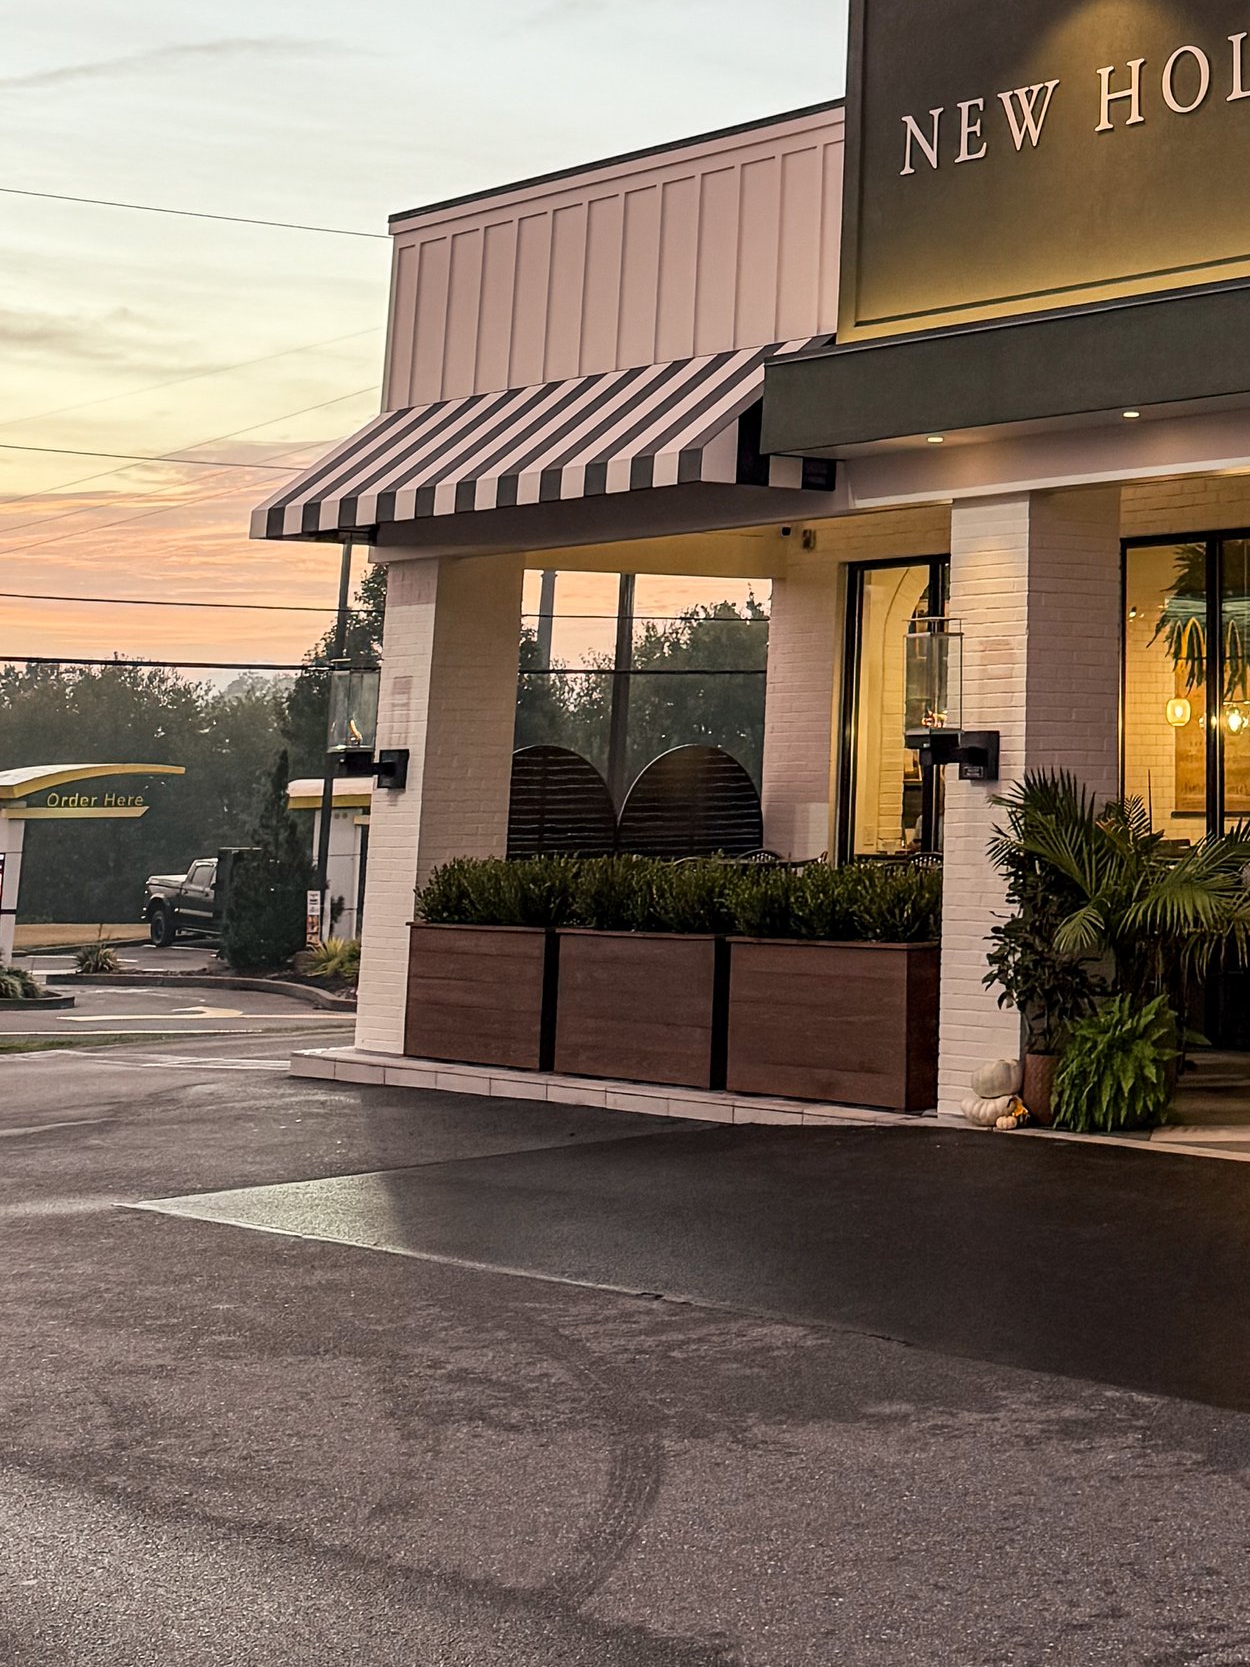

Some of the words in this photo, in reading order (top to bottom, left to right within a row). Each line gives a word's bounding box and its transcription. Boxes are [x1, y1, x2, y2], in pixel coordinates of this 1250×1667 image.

[899, 78, 1060, 176] NEW
[47, 792, 98, 807] Order
[104, 792, 144, 807] Here
